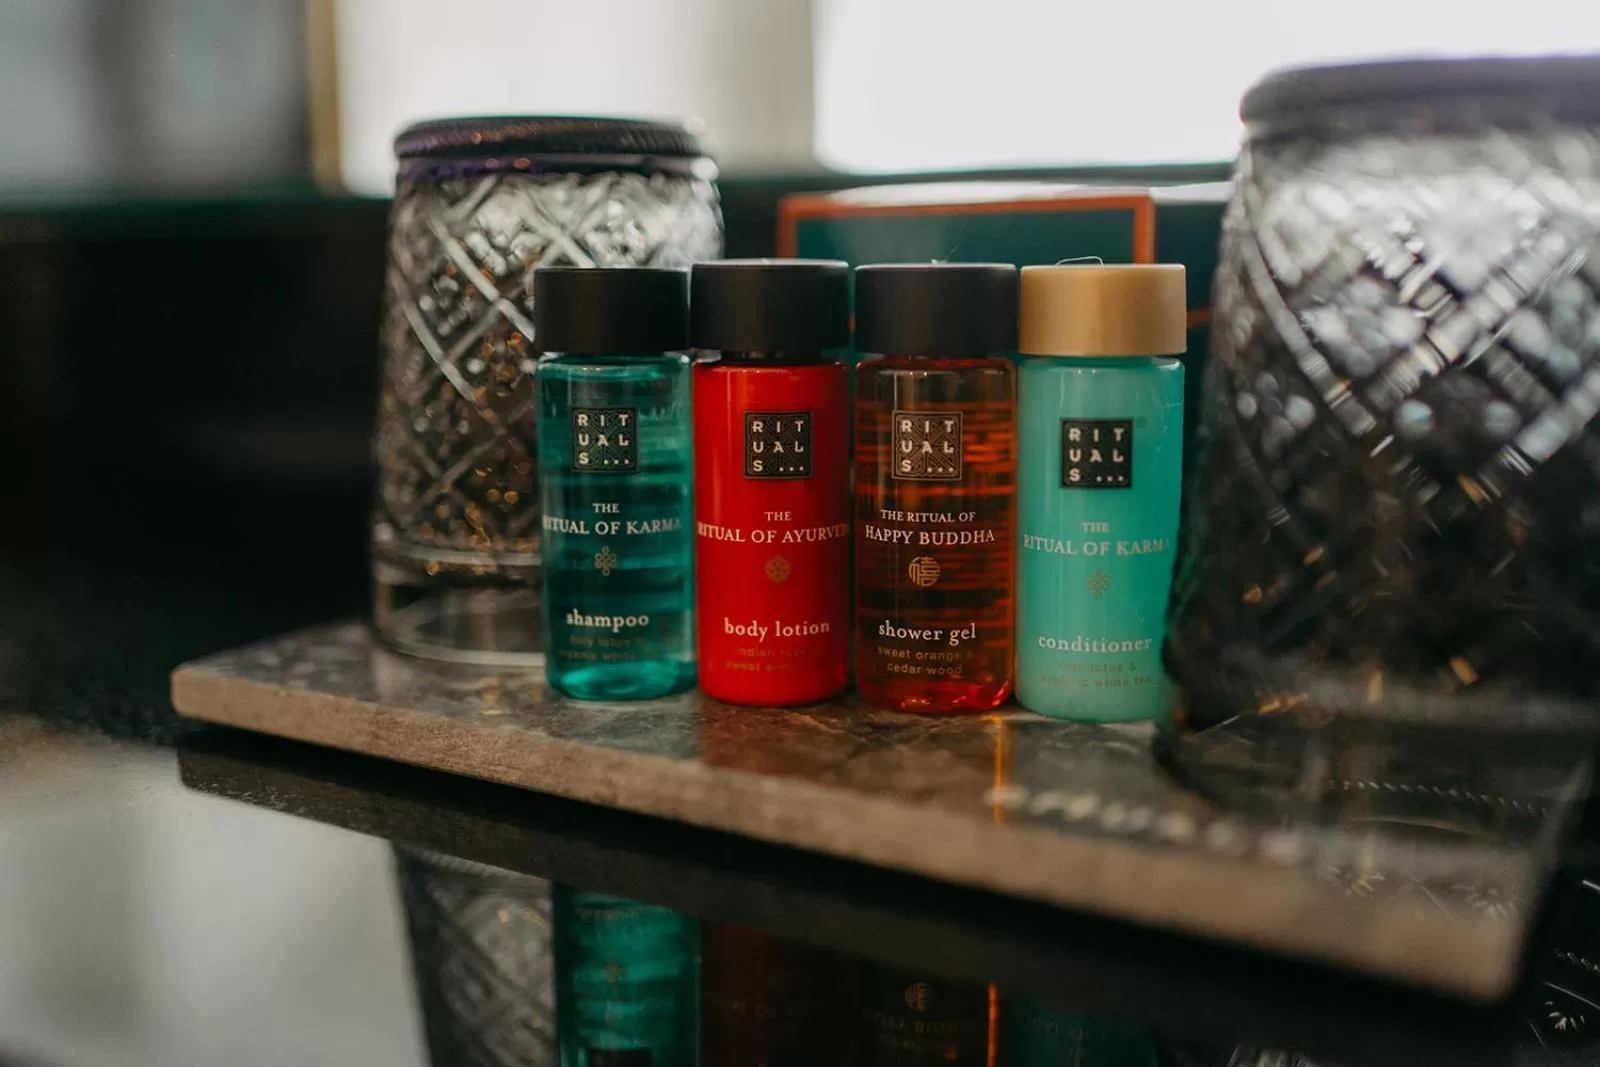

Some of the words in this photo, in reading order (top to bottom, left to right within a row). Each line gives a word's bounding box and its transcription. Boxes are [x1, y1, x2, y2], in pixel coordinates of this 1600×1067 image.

[577, 414, 629, 426] RIT
[752, 420, 804, 433] RIT
[901, 420, 955, 433] RIT
[578, 433, 629, 446] UAL
[1068, 428, 1125, 442] RIT
[752, 441, 804, 453] UAL
[901, 441, 955, 454] UAL
[1068, 449, 1125, 463] UAL
[592, 503, 620, 514] THE
[764, 511, 792, 521] THE
[880, 509, 904, 521] THE
[906, 512, 956, 523] RITUAL
[958, 512, 976, 522] OF
[594, 521, 621, 535] OF
[1082, 522, 1110, 533] THE
[751, 530, 777, 543] OF
[865, 524, 914, 545] HAPPY
[919, 529, 995, 546] BUDDHA
[1023, 534, 1077, 555] RITUAL
[1083, 541, 1110, 556] OF
[566, 608, 649, 633] shampoo
[724, 616, 769, 643] body
[775, 620, 830, 637] lotion
[878, 620, 943, 641] shower
[949, 622, 976, 647] gel
[1038, 635, 1153, 653] conditioner
[876, 645, 911, 660] sweet
[915, 649, 962, 662] orange
[887, 661, 921, 675] cedar
[926, 664, 963, 676] wood
